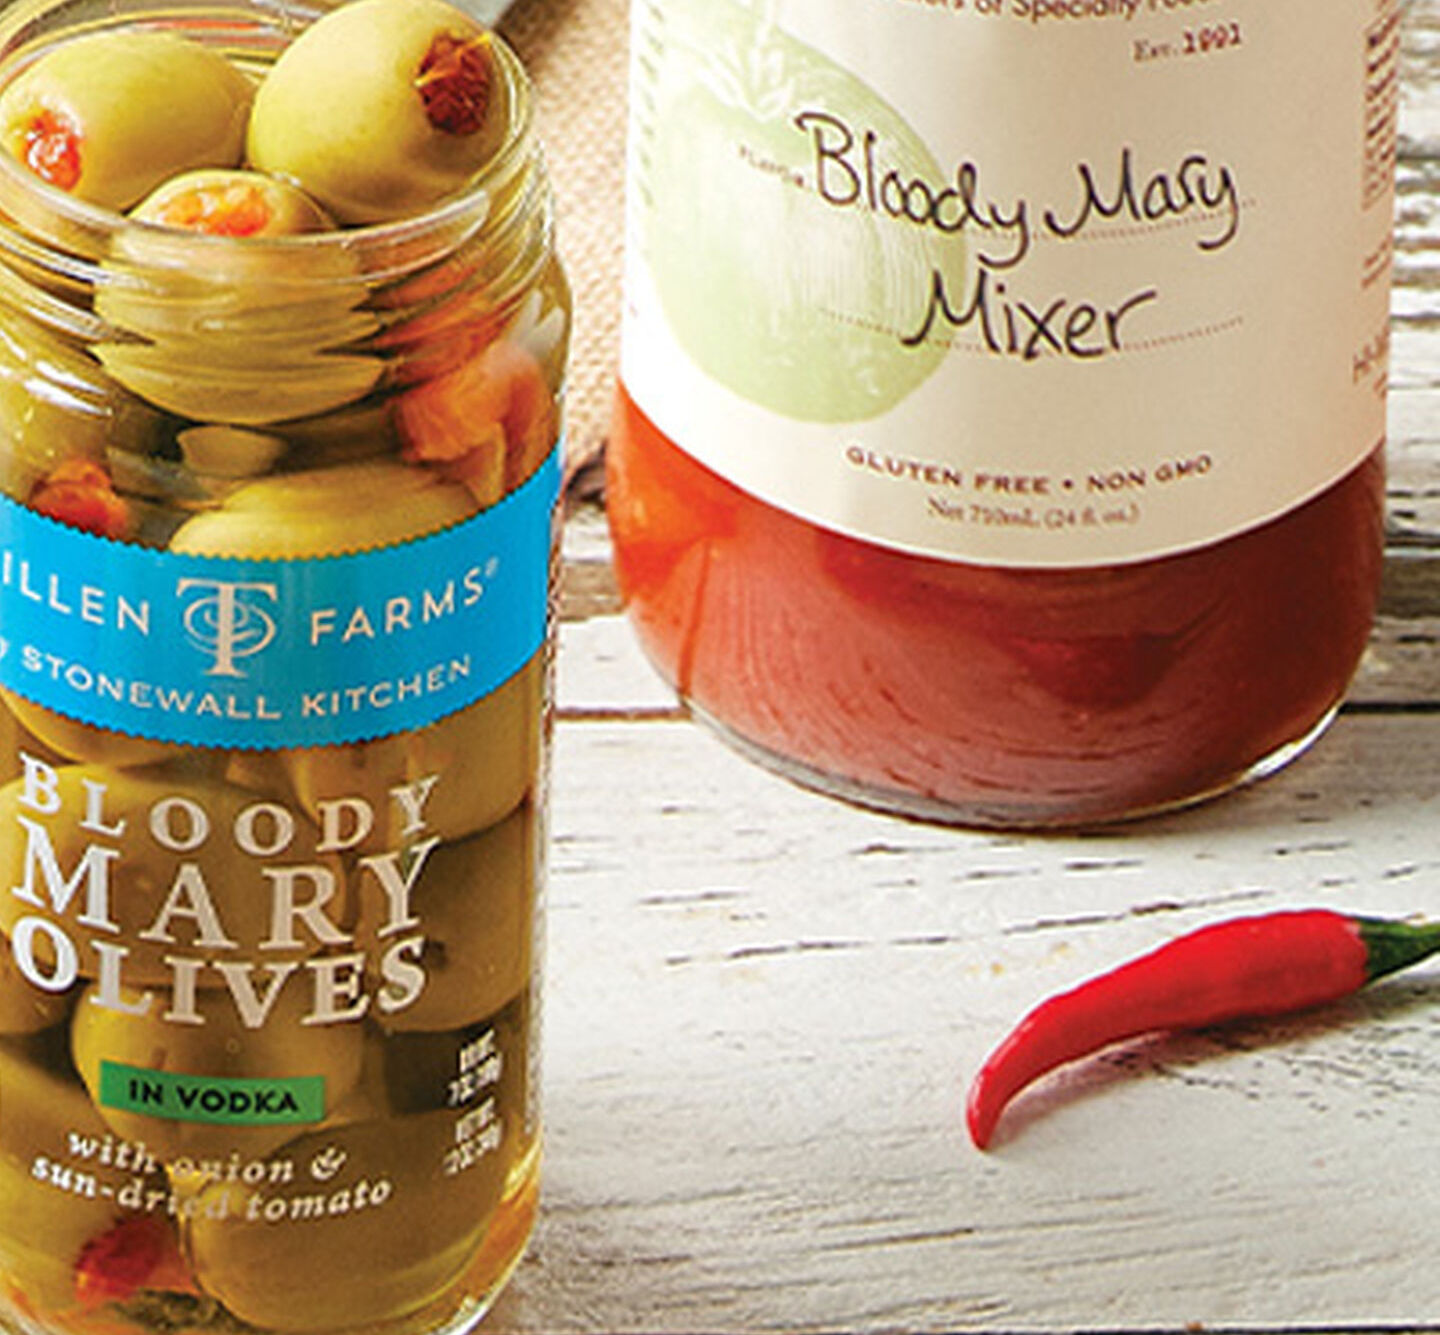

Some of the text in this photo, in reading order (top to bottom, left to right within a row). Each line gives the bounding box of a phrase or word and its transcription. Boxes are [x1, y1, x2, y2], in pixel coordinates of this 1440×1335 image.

[793, 111, 1242, 268] Bloody Mary
[901, 270, 1157, 360] Mixer
[846, 446, 1213, 494] GLUTEN FREE NON GMO
[22, 645, 282, 720] STONEWALL
[301, 653, 471, 717] KITCHEN
[17, 752, 440, 856] BLOODY
[11, 817, 442, 951] MARY
[10, 915, 428, 1029] OLIVES
[128, 1078, 300, 1116] IN VODKA
[67, 1131, 348, 1184] with onion &
[245, 1178, 394, 1223] tomato
